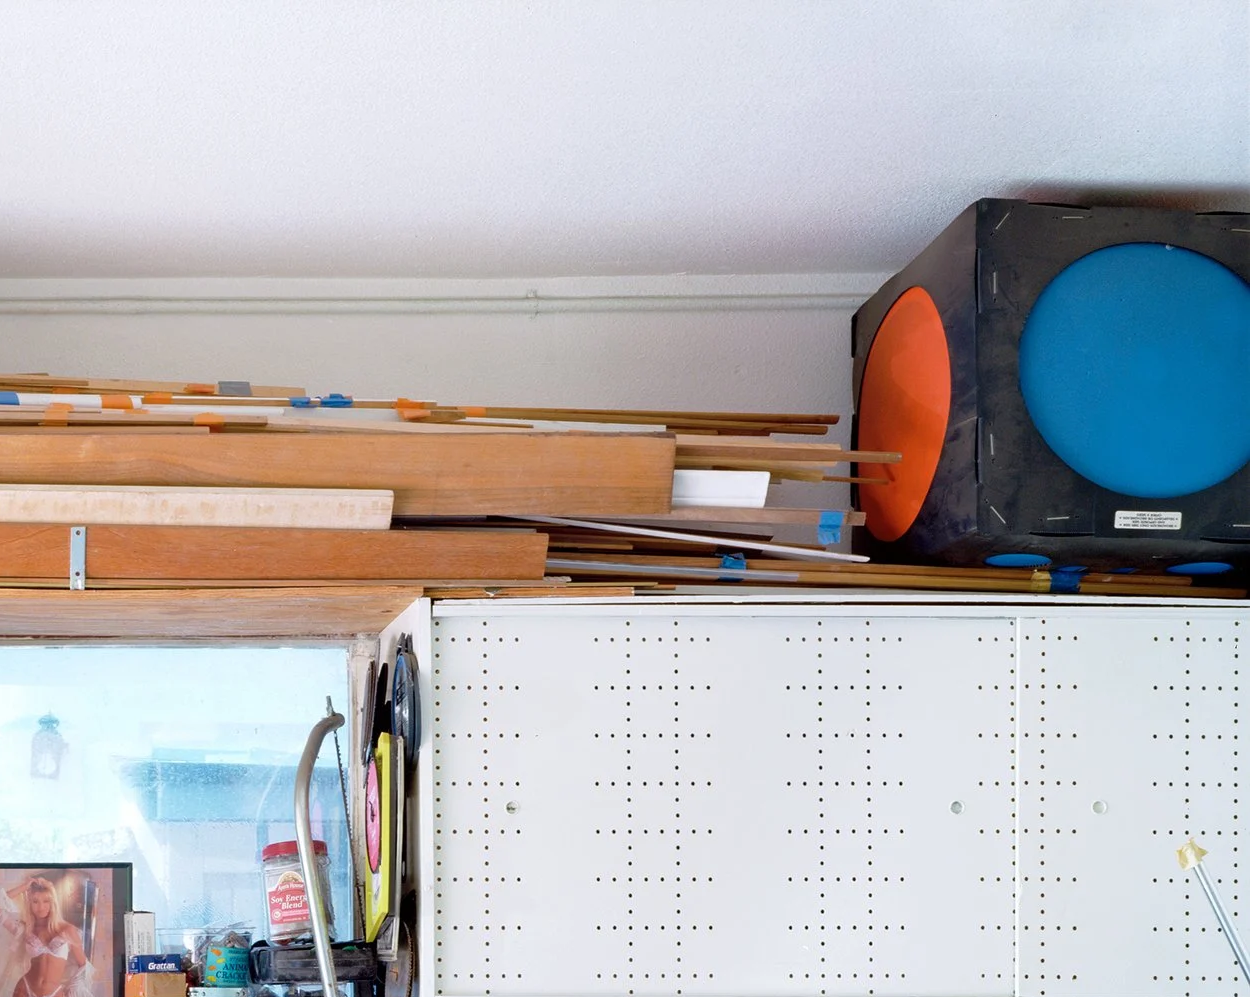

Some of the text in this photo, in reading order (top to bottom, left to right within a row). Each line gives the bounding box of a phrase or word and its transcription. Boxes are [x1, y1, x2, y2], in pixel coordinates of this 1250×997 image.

[271, 894, 308, 906] Soy Energ
[282, 901, 303, 910] Blend
[148, 962, 176, 970] Grattan
